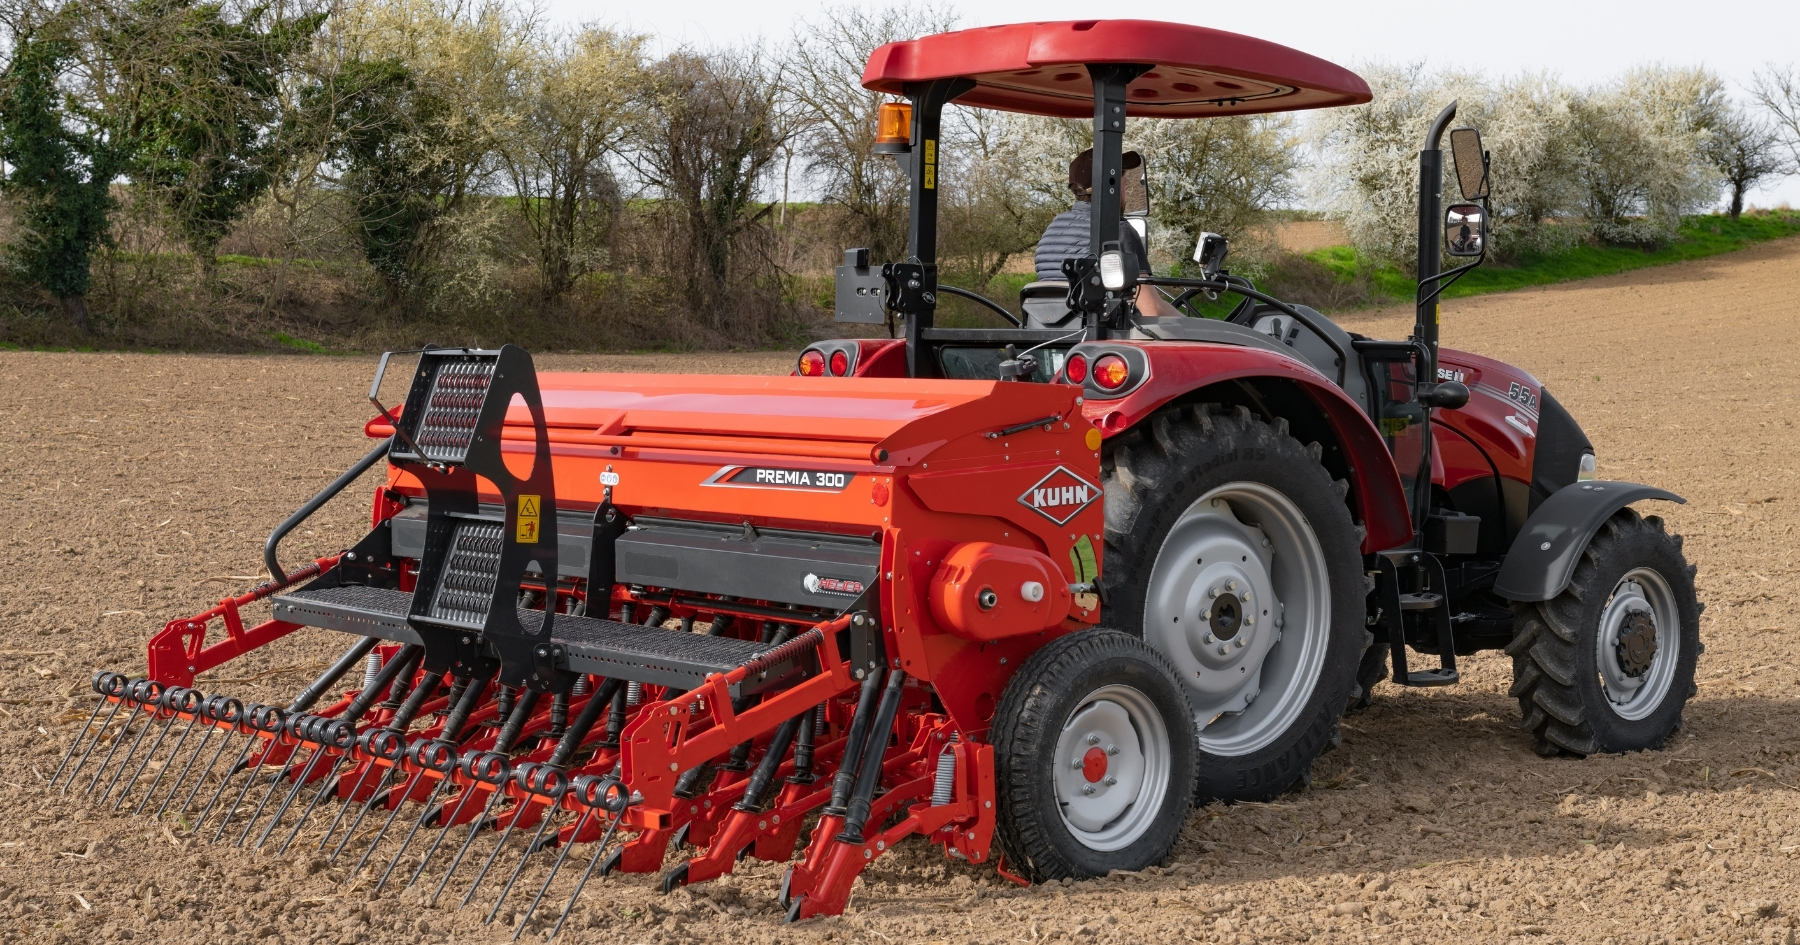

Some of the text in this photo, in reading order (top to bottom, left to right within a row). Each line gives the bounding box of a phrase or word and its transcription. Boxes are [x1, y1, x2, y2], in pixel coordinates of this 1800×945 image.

[1438, 368, 1453, 380] SE
[1508, 381, 1537, 410] 55A
[1189, 449, 1239, 483] Radial
[756, 469, 844, 487] PREMIA 300
[1034, 485, 1088, 508] KUHN
[819, 578, 861, 592] HELICA
[1237, 700, 1332, 792] ALLIANCE
